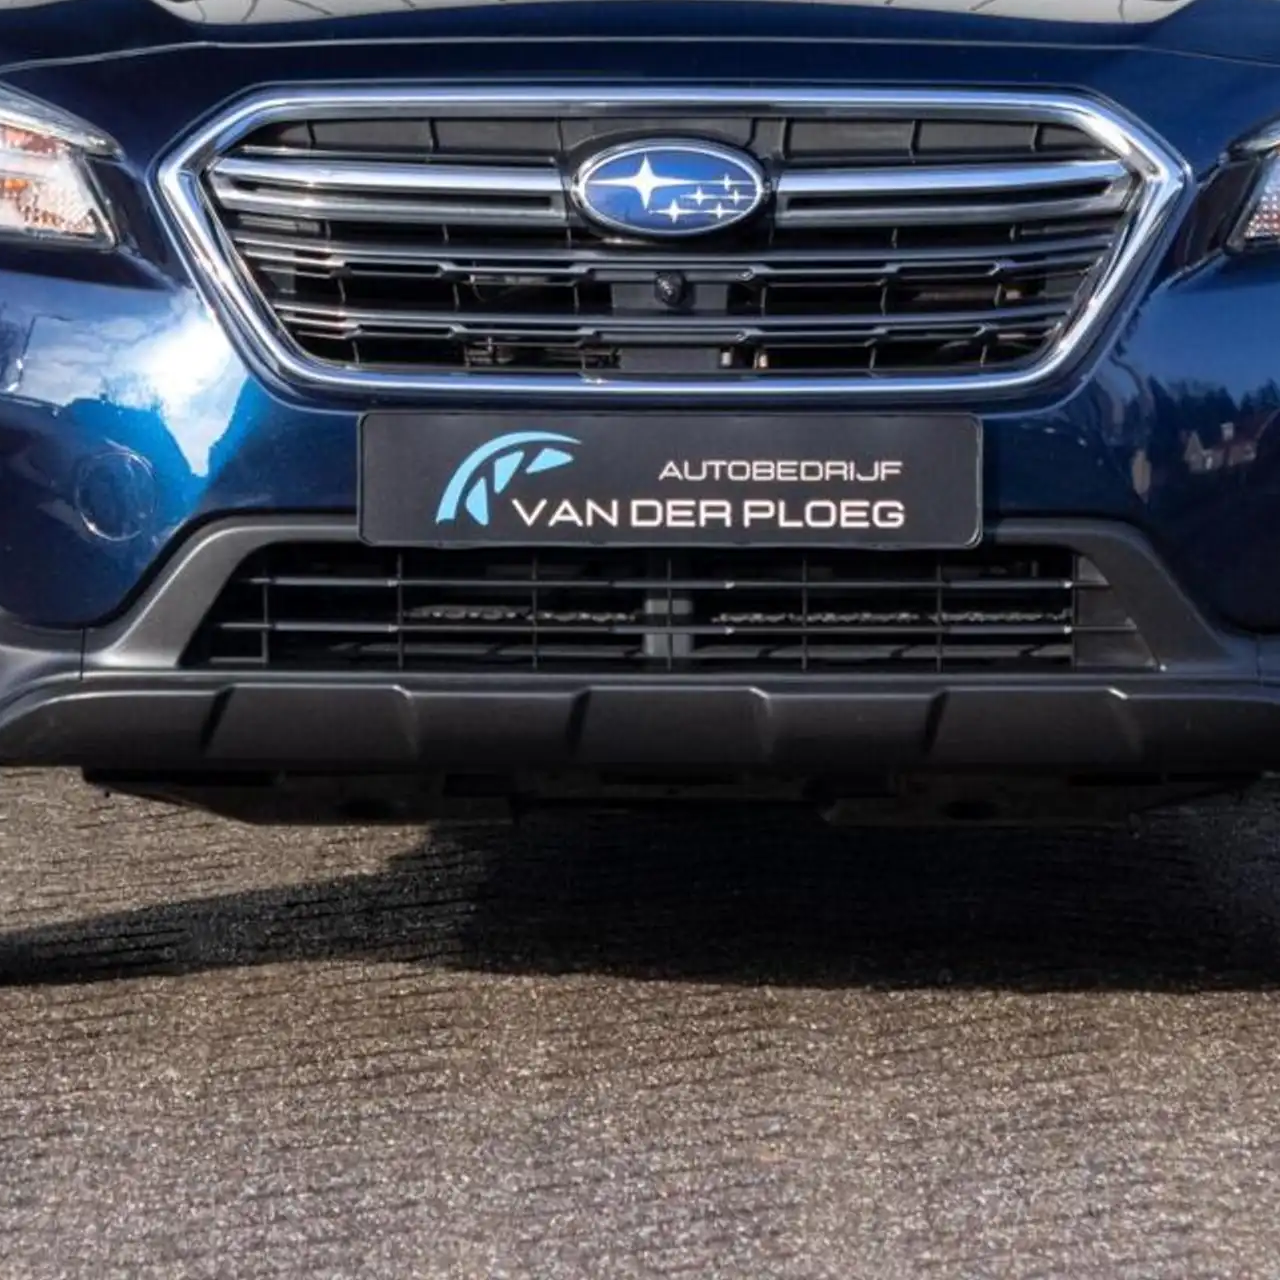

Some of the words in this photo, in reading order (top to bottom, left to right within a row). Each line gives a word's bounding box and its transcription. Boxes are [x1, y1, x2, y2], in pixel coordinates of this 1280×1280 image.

[658, 459, 904, 482] AUTOBEDRIJF
[511, 497, 620, 529] VAN
[629, 497, 734, 529] DER
[742, 497, 906, 529] PLOEG
